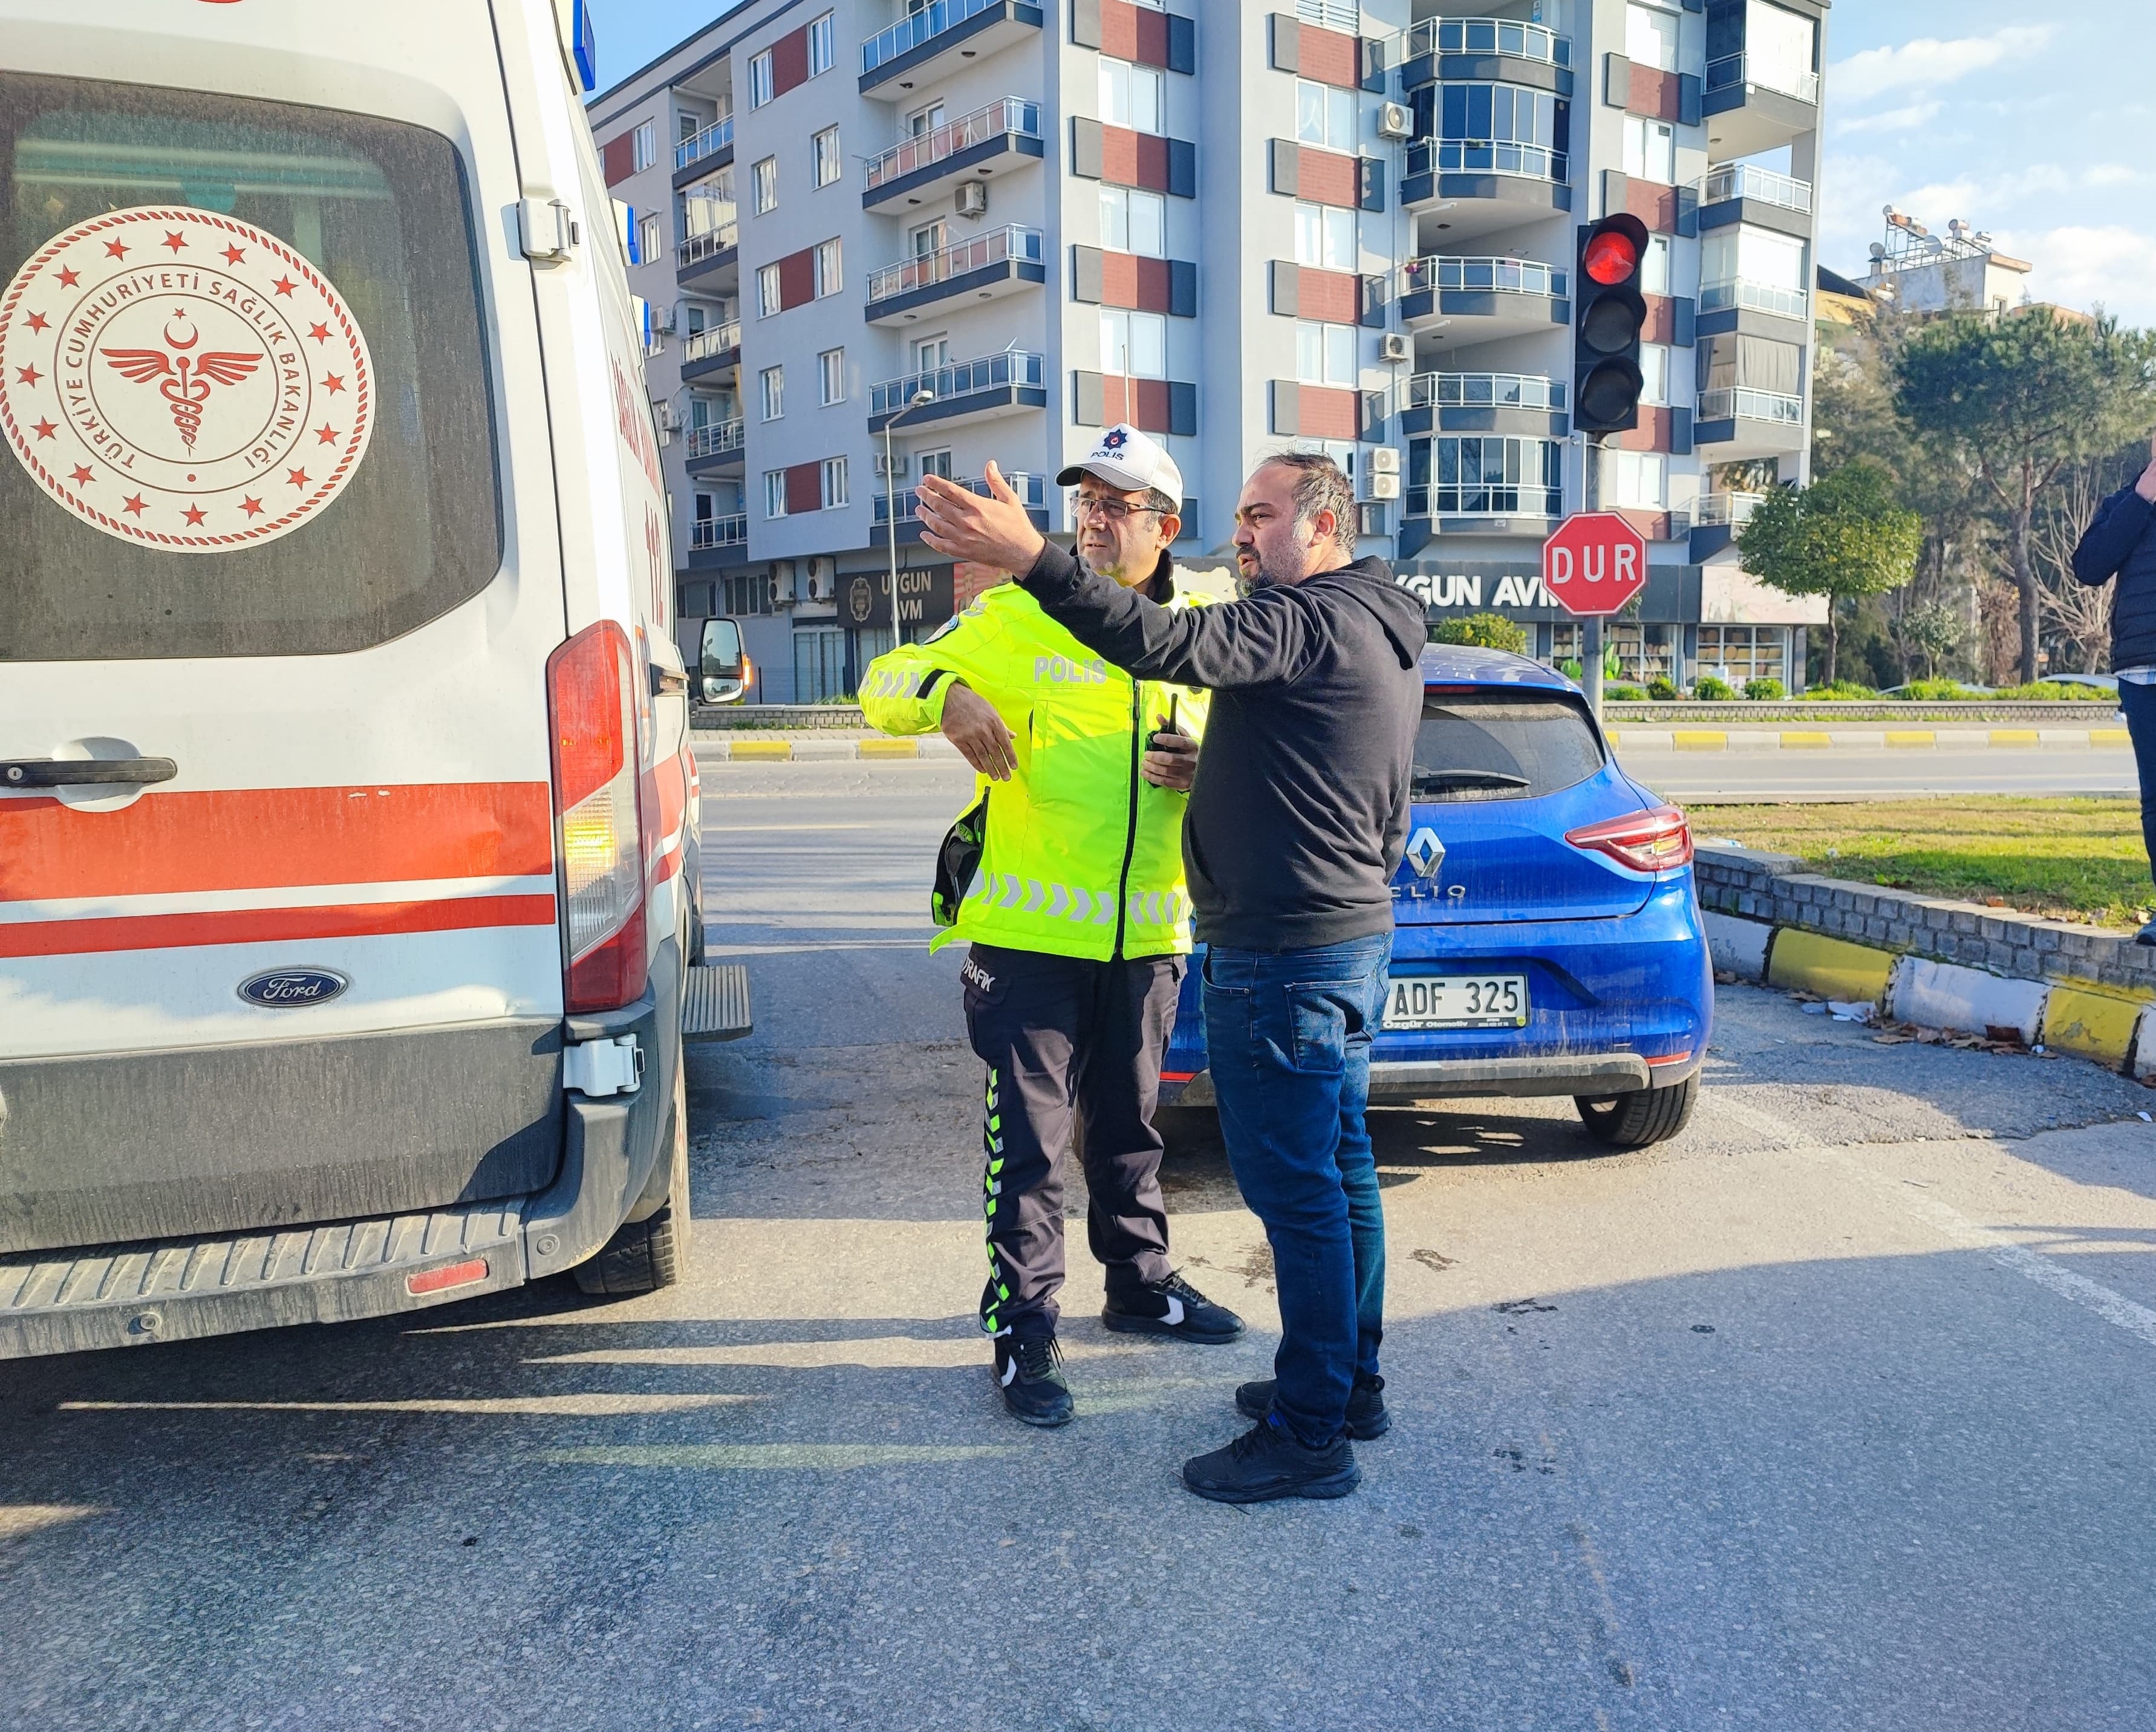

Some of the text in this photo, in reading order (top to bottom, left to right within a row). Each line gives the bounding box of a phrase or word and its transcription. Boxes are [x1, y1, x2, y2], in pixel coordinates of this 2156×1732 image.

[65, 272, 301, 470] TÜRKİYE CUMHURİYETİ SAĞLIK BAKANLIĞI
[1552, 544, 1637, 585] DUR
[262, 977, 322, 1000] Ford
[1394, 981, 1518, 1015] ADF 325
[1383, 1019, 1424, 1030] Özgür
